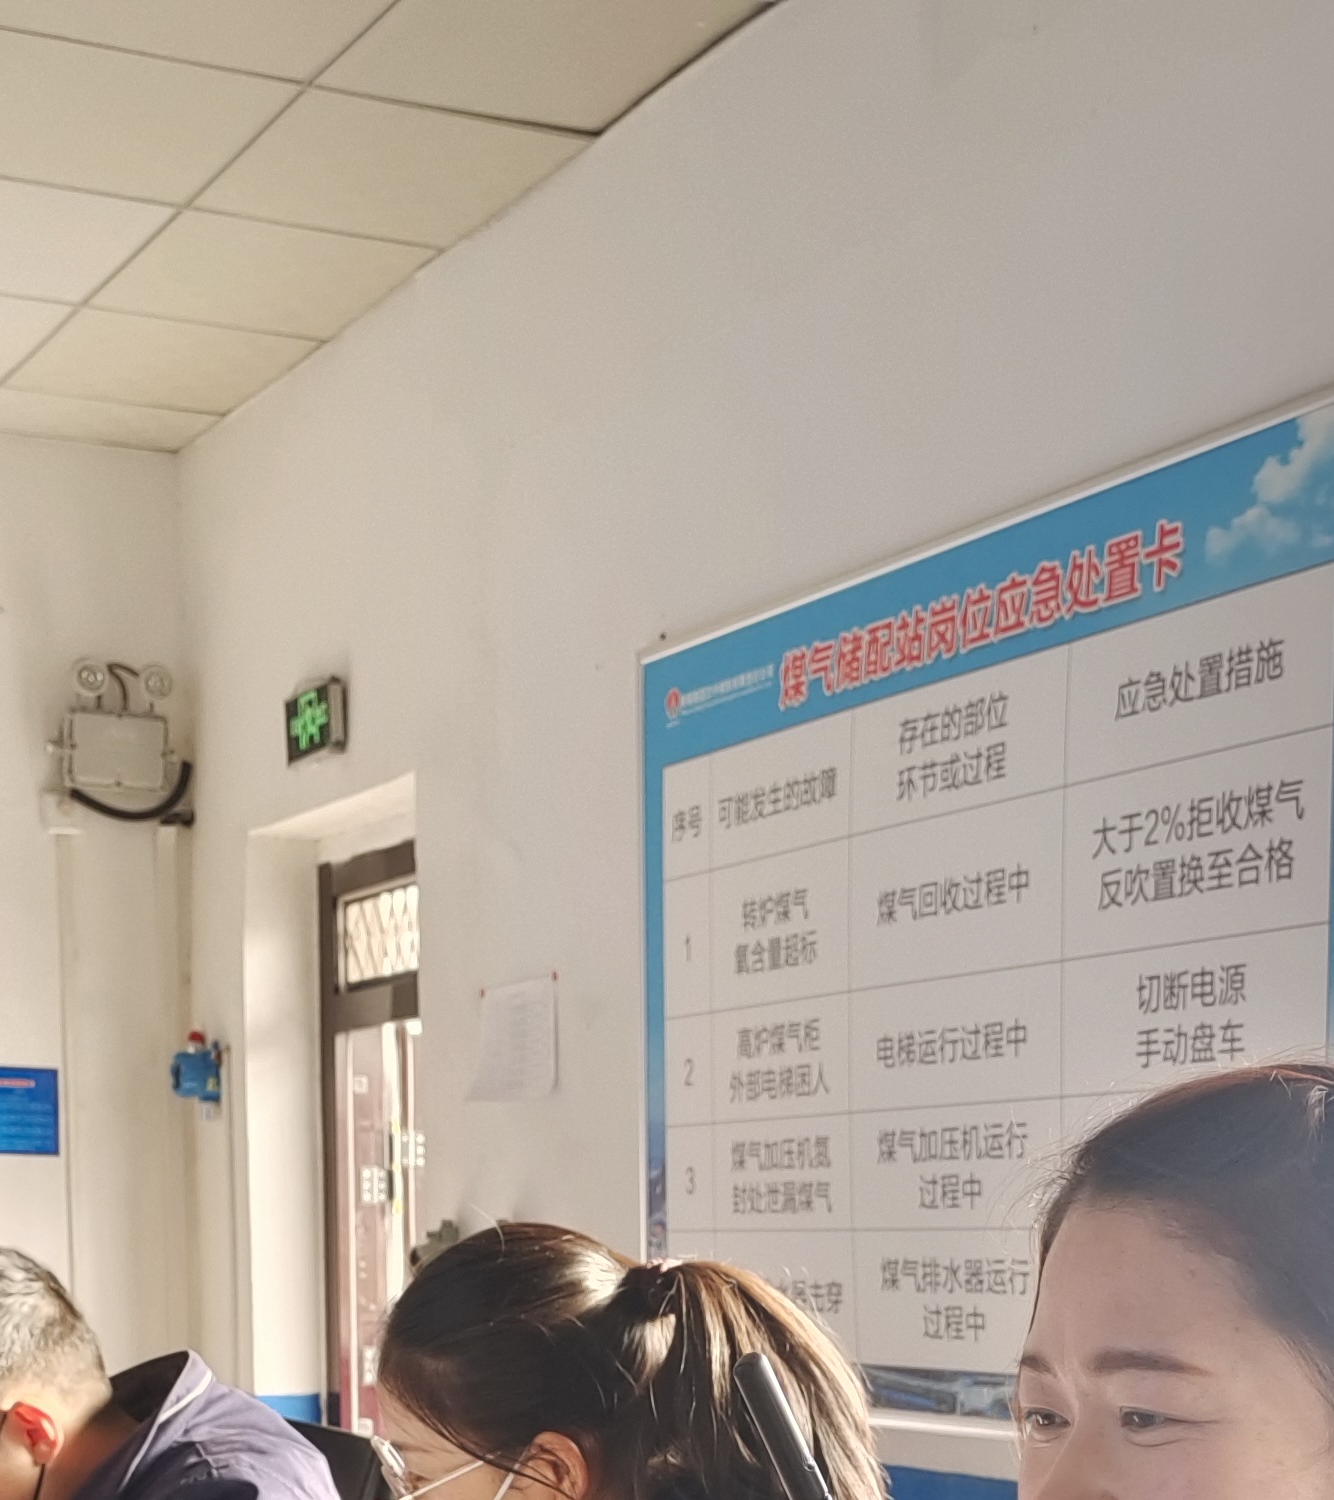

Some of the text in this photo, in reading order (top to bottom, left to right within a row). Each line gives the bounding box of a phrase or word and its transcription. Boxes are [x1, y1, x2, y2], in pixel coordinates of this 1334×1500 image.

[779, 522, 1184, 710] 煤气储配站岗位应急处置卡
[1114, 638, 1285, 721] 应急处置措施
[899, 691, 1009, 755] 存在的部位
[896, 742, 1006, 801] 环节或过程
[717, 767, 838, 829] 可能发生的故障
[1092, 778, 1306, 860] 大于2%拒收煤气
[671, 805, 702, 842] 序号
[876, 863, 1030, 926] 煤气回收过程中
[1096, 837, 1296, 911] 反吹置换至合格
[741, 888, 810, 930] 转炉煤气
[684, 936, 691, 961] 1
[1135, 962, 1247, 1015] 切断电源
[736, 1019, 821, 1059] 高炉煤气柜
[875, 1018, 1028, 1068] 电梯运行过程中
[1135, 1020, 1246, 1069] 手动盘车
[683, 1058, 694, 1086] 2
[729, 1062, 830, 1103] 外部电梯困人
[876, 1121, 1028, 1164] 煤气加压机运行
[685, 1166, 696, 1195] 3
[918, 1172, 983, 1209] 过程中
[879, 1257, 1030, 1296] 煤气排水器运行
[922, 1306, 986, 1342] 过程中
